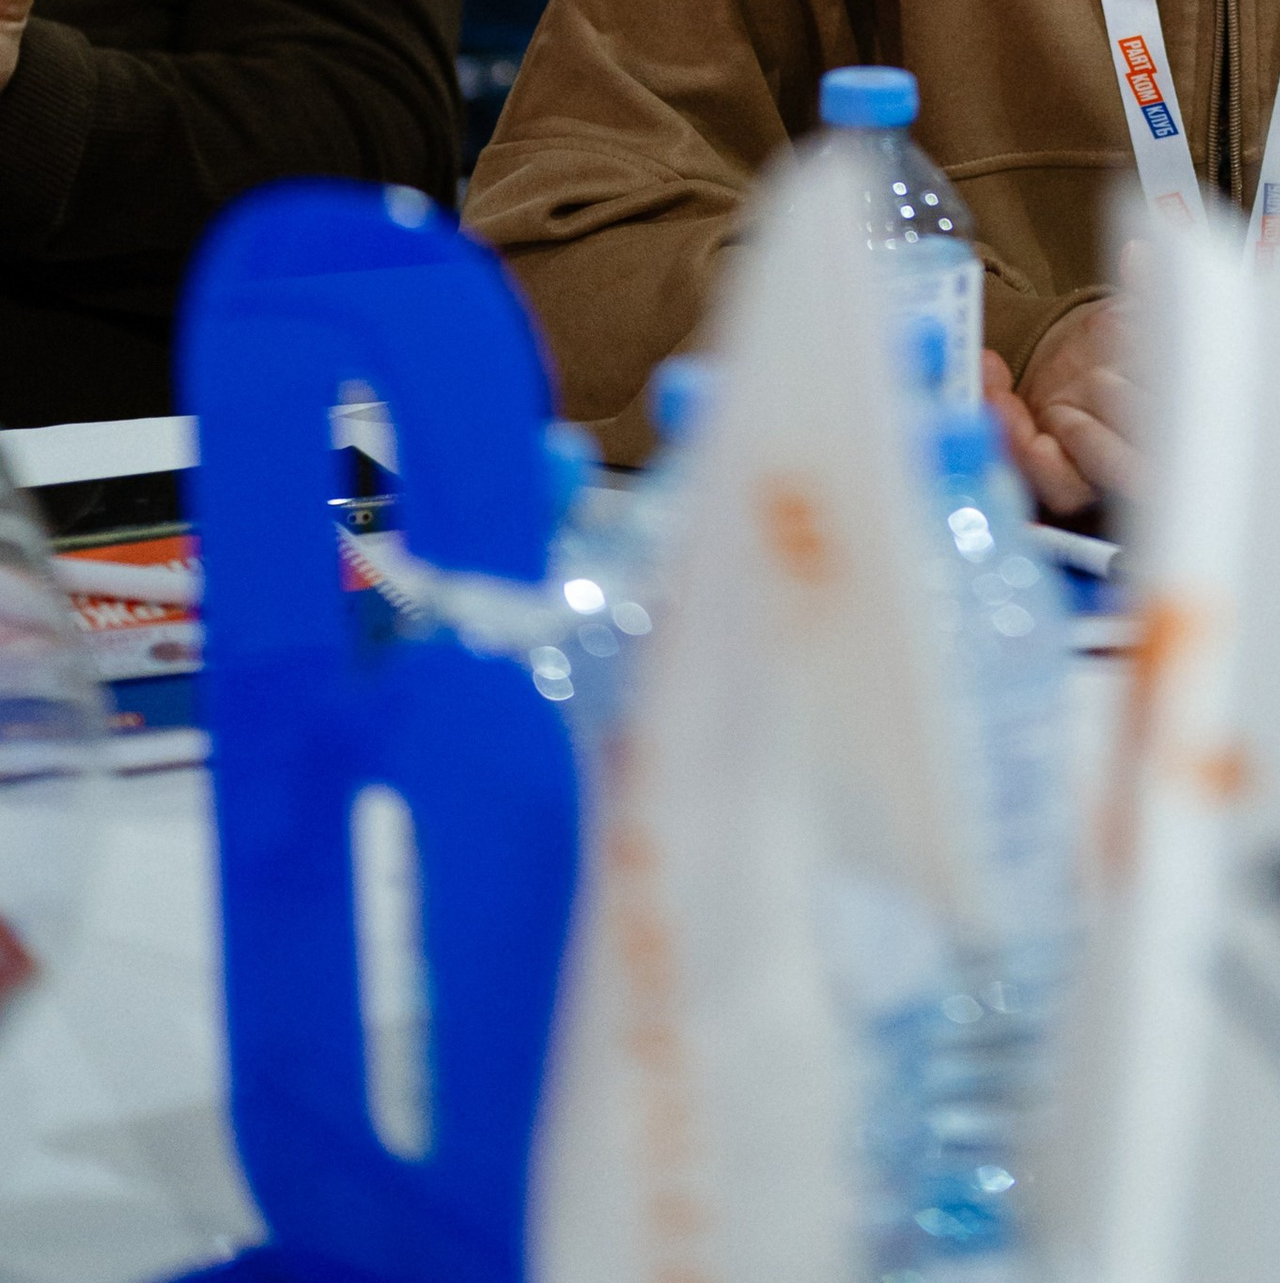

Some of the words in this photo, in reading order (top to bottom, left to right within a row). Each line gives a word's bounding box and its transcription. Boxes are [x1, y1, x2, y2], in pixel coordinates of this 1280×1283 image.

[1123, 40, 1152, 71] PART
[1130, 72, 1159, 102] KOM
[1146, 105, 1175, 137] КЛУБ
